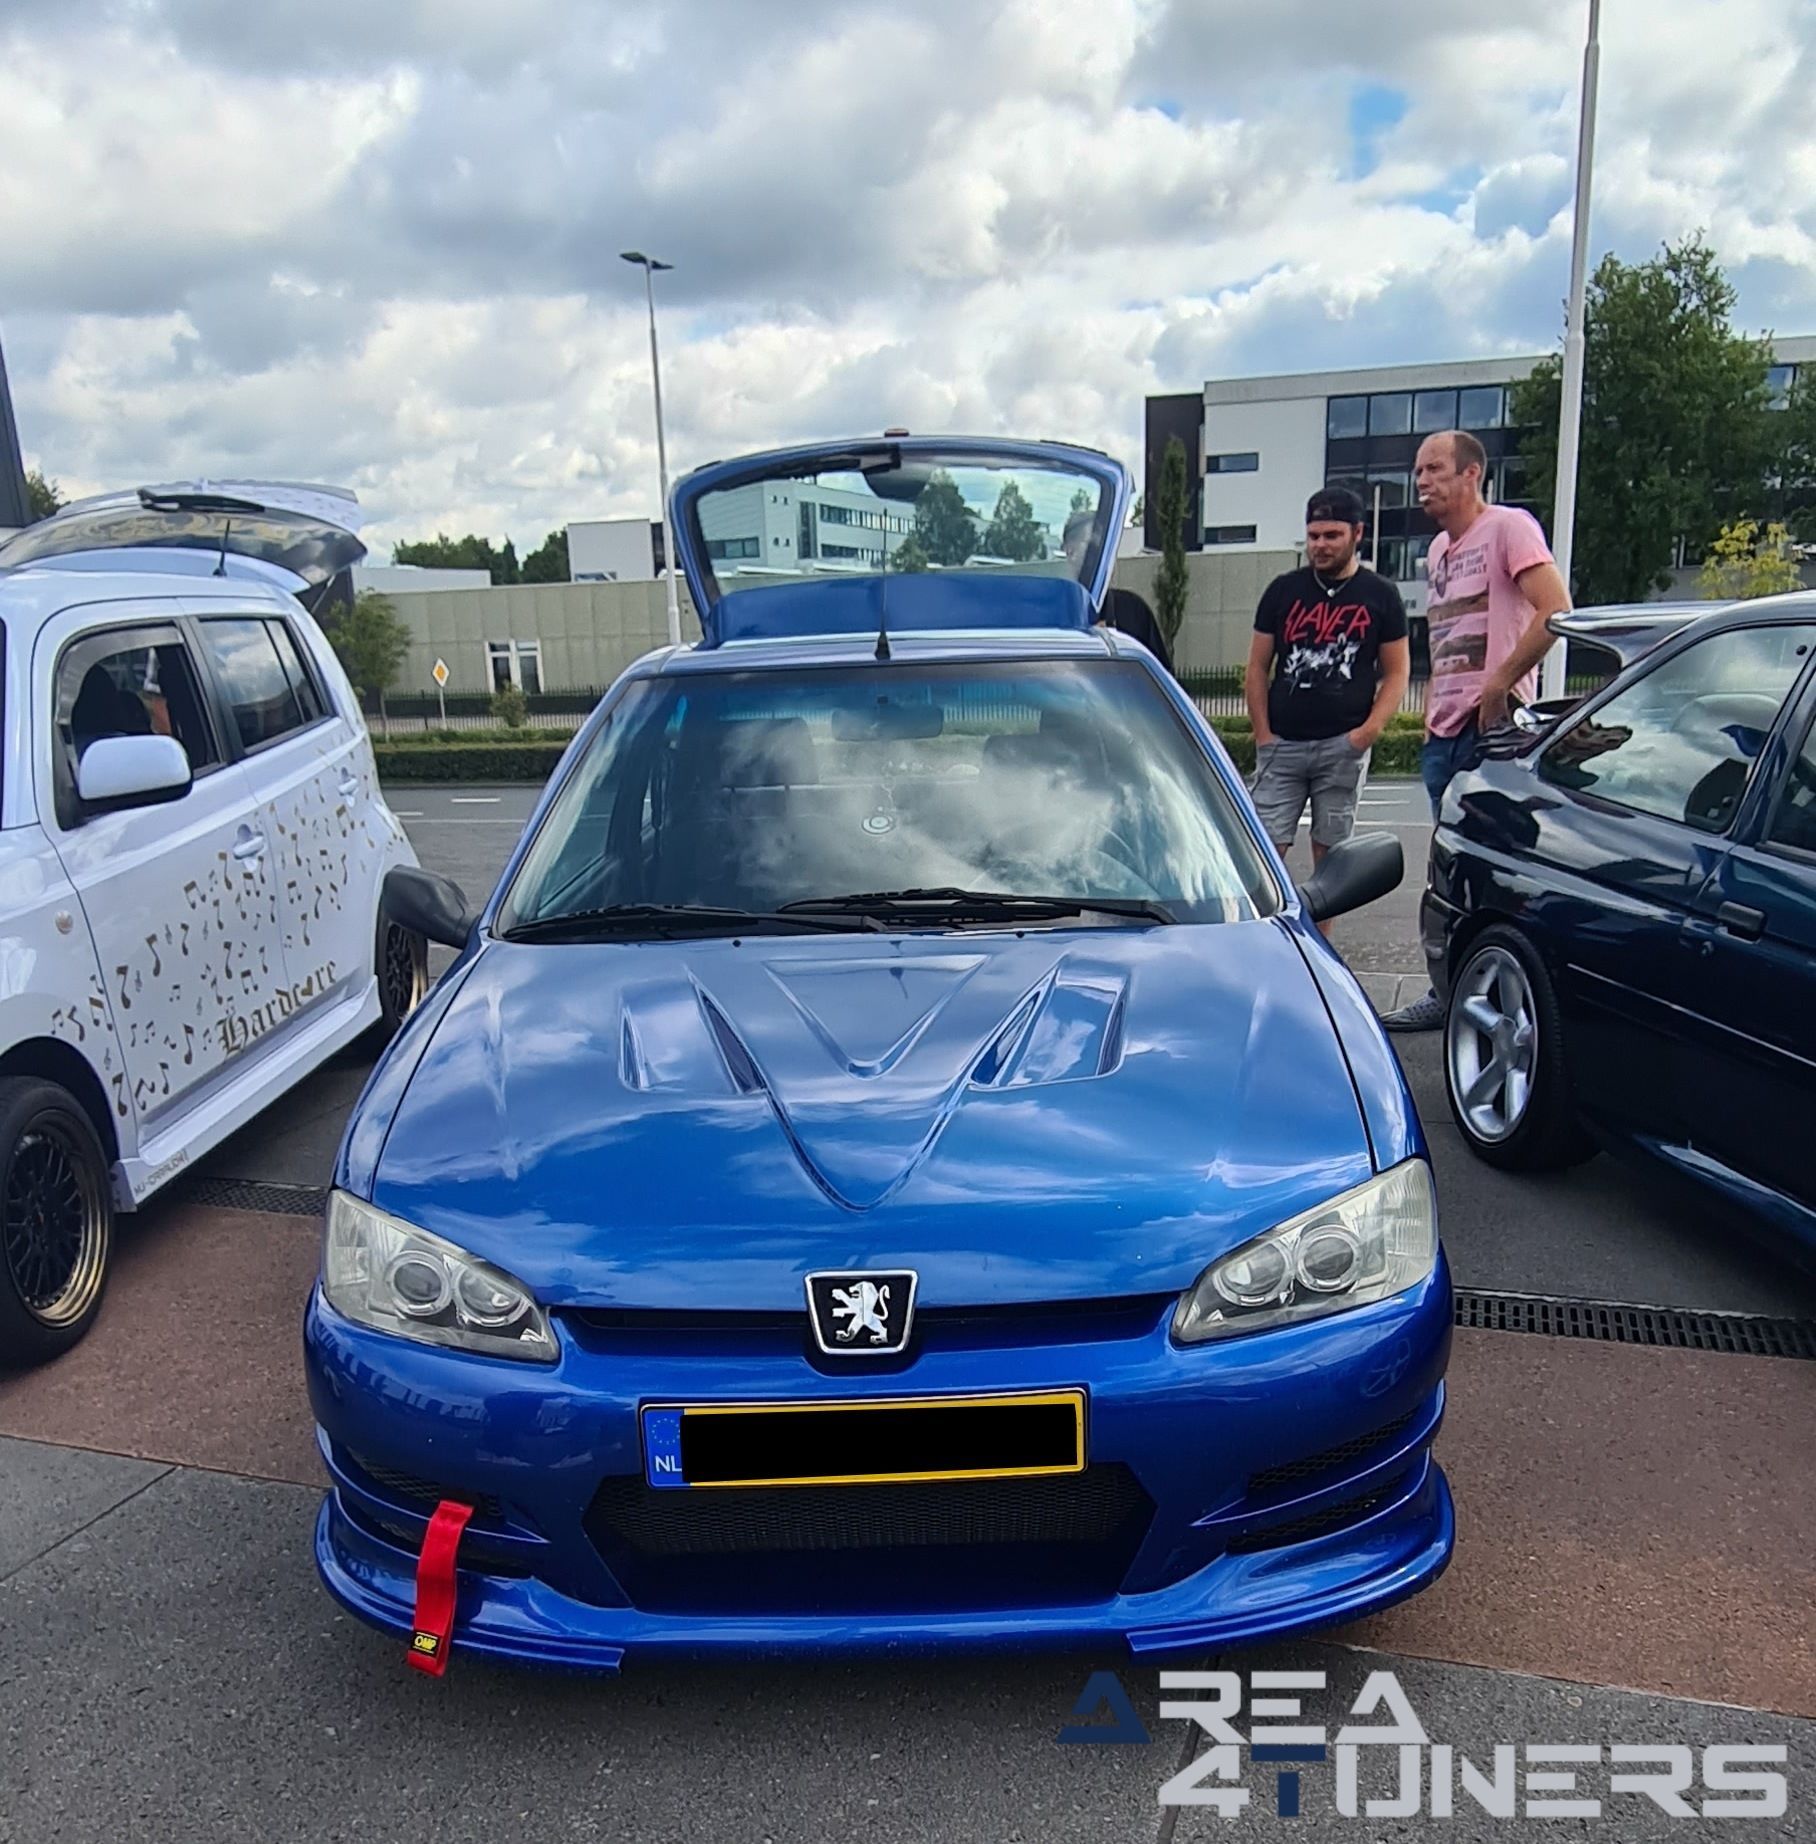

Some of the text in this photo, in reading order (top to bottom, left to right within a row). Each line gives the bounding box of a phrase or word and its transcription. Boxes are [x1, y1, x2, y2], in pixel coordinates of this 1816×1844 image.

[1284, 599, 1371, 644] SLAYER
[655, 1455, 682, 1472] NL
[414, 1635, 437, 1650] OMP
